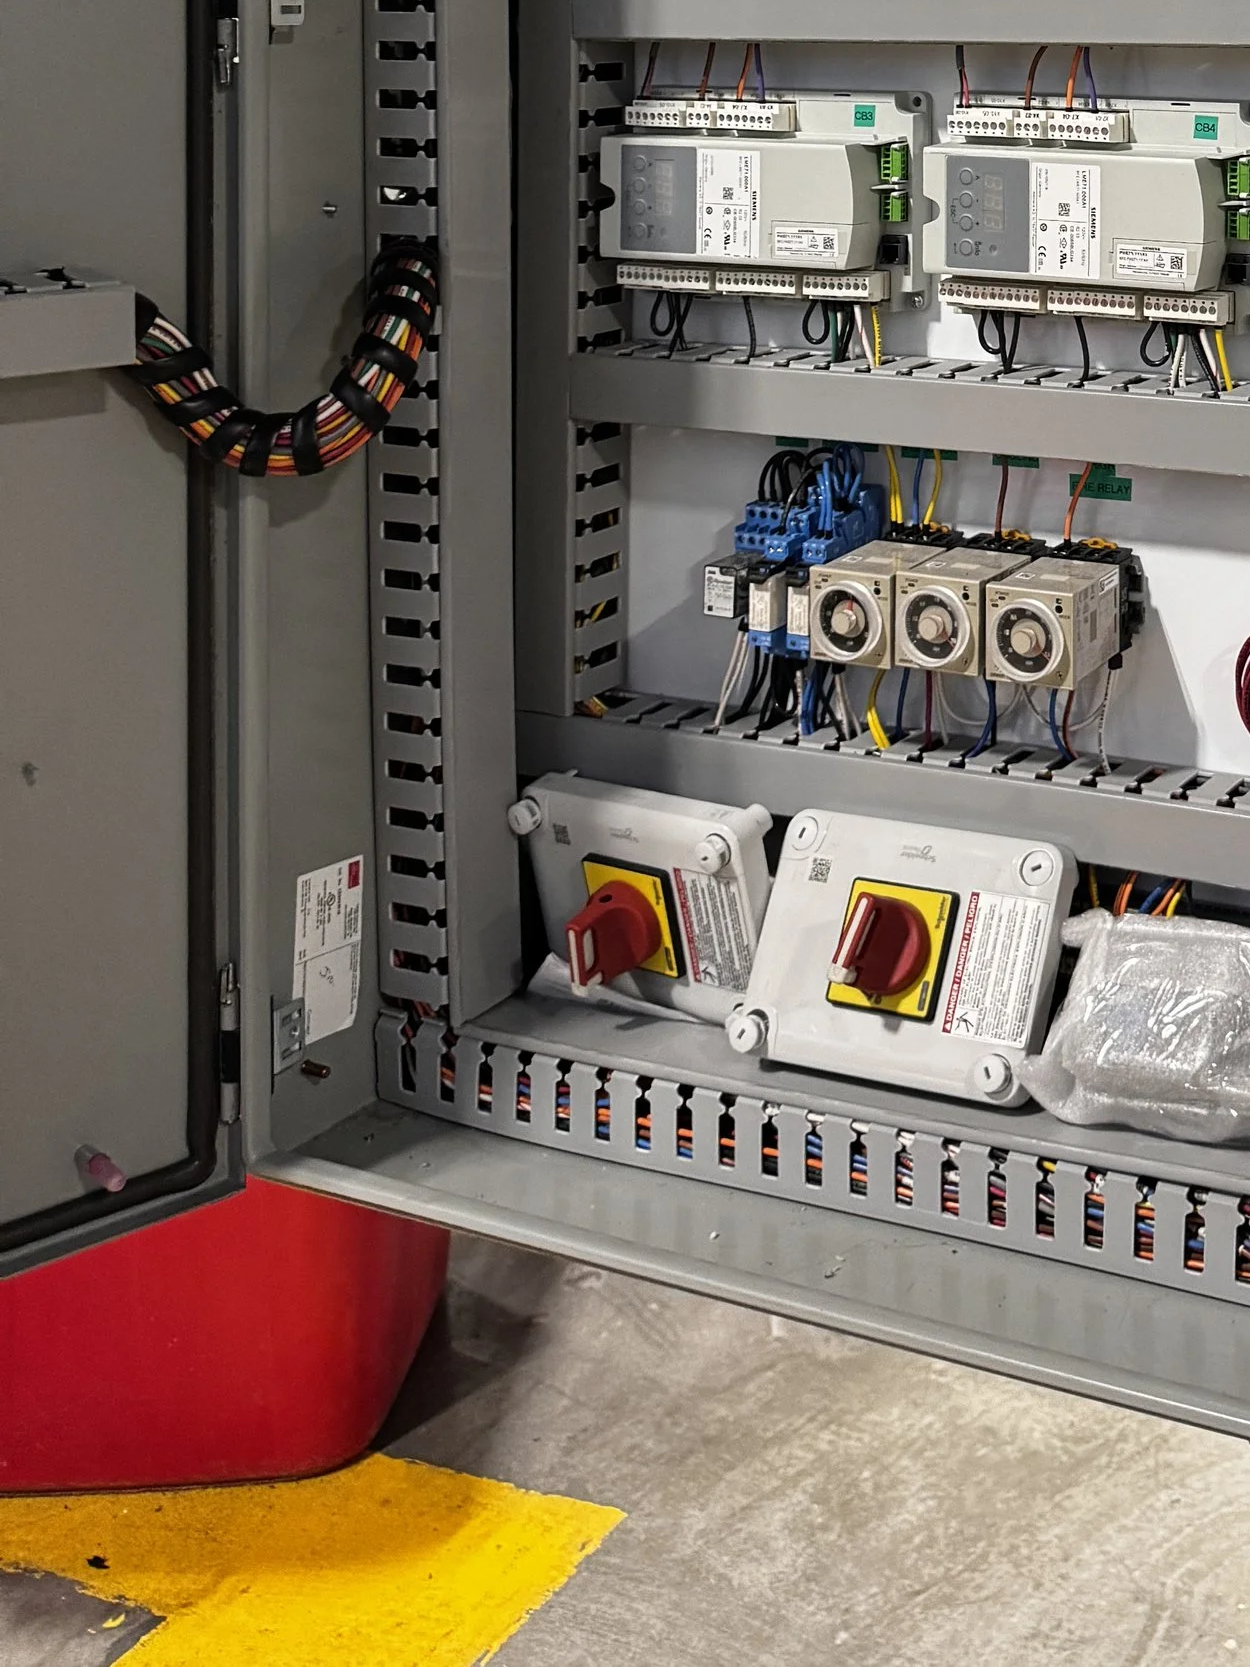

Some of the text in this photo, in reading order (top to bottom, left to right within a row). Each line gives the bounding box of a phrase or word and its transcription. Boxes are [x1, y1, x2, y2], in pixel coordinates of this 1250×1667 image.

[855, 110, 873, 121] CB3
[1195, 122, 1216, 133] CB4
[1098, 485, 1130, 494] RELAY
[947, 895, 978, 1021] DANGER DANGER PELIGRO
